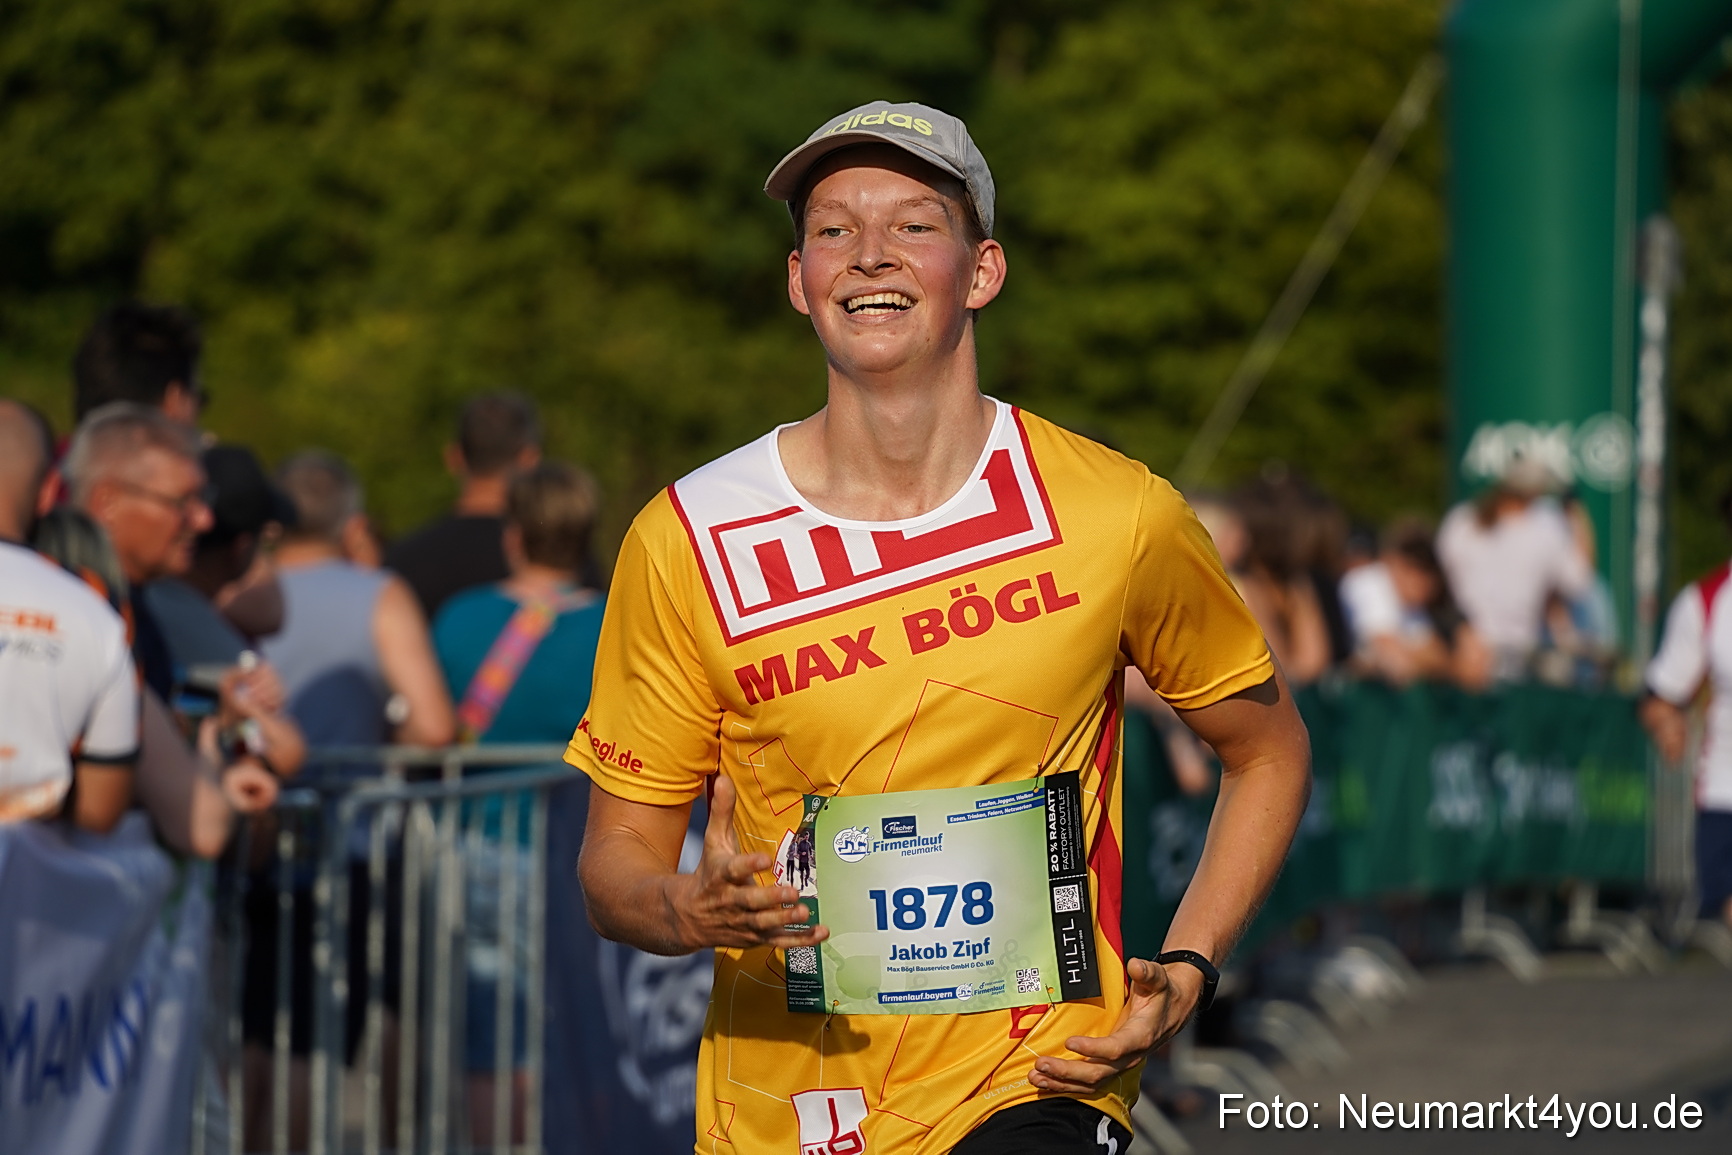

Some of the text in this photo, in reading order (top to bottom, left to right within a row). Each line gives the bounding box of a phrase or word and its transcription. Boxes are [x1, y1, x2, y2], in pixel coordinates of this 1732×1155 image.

[822, 110, 933, 136] didas
[734, 570, 1080, 705] MAX BÖGL
[1047, 788, 1060, 873] 20 % RABATT
[1058, 787, 1070, 871] FACTORY OUTLET
[872, 833, 944, 853] Firmenlauf
[901, 844, 943, 857] neumarkt
[868, 881, 994, 931] 1878
[888, 936, 991, 961] Jakob Zipf
[1062, 918, 1081, 983] HILTL
[901, 965, 915, 974] Bögl
[916, 964, 951, 972] Bauservice
[951, 962, 970, 970] GmbH
[881, 991, 953, 1002] firmenlauf.bayern
[983, 1078, 1029, 1100] ULTRADR
